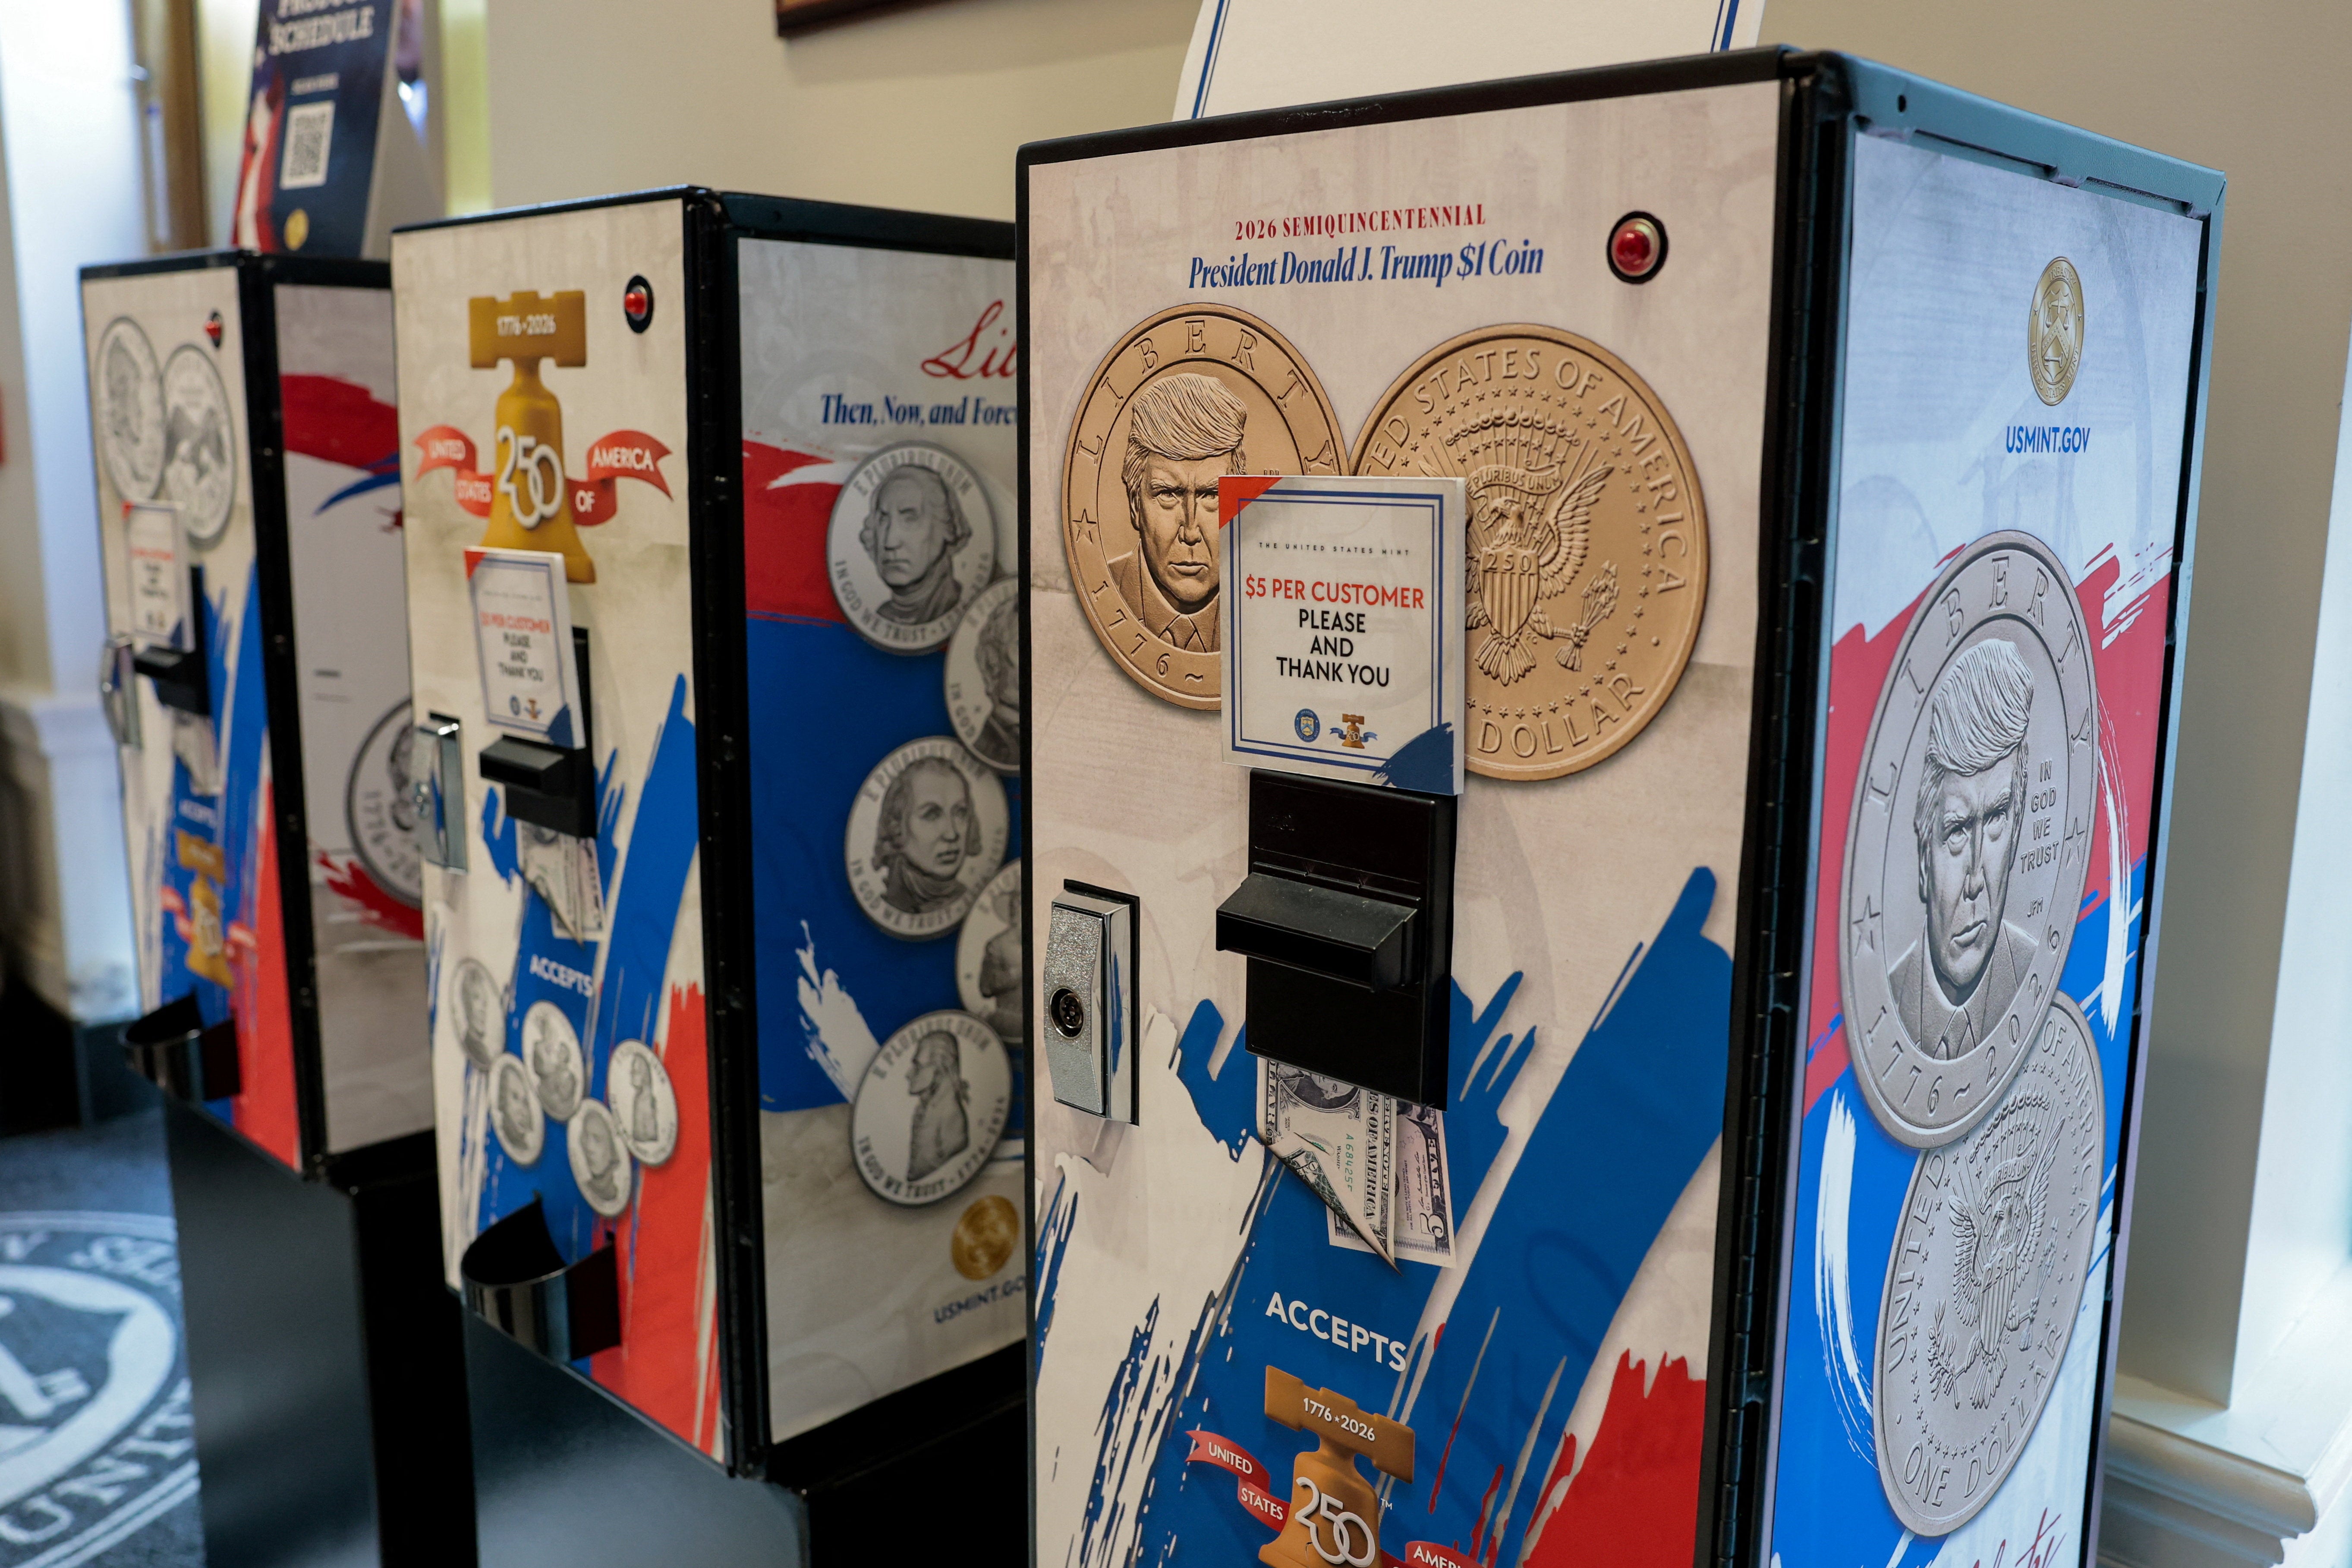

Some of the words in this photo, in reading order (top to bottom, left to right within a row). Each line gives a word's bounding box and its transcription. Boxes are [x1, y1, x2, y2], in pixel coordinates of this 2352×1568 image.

[268, 5, 375, 56] SCHEDULE
[1234, 219, 1277, 241] 2026
[1283, 203, 1486, 239] SEMIQUINCENTENNIAL
[1189, 252, 1278, 289] President
[1279, 246, 1357, 284] Donald
[1357, 246, 1373, 281] J.
[1381, 244, 1454, 287] Trump
[1457, 239, 1486, 280] $1
[1489, 239, 1544, 276] Coin
[2049, 267, 2076, 288] TREASURY
[497, 316, 521, 336] 1776
[526, 315, 556, 336] 2026
[2046, 382, 2065, 398] STATES
[2068, 346, 2078, 383] MINT
[822, 393, 878, 427] Then,
[882, 394, 925, 427] Now,
[929, 396, 968, 425] and
[1076, 320, 1336, 474] LIBERTY
[428, 438, 466, 461] UNITED
[2006, 425, 2091, 453] USMINT.GOV
[592, 446, 655, 472] AMERICA
[1414, 348, 1541, 415] STATES
[1555, 358, 1603, 399] OF
[1598, 393, 1688, 595] AMERICA
[456, 479, 492, 504] STATES
[497, 425, 564, 529] 250
[1472, 468, 1526, 487] PLURIBUS
[1528, 475, 1560, 491] UNUM
[575, 490, 595, 512] OF
[1487, 553, 1532, 573] 250
[1246, 574, 1266, 599] $5
[1272, 579, 1306, 600] PER
[1312, 581, 1424, 609] CUSTOMER
[1092, 581, 1171, 678] 1776
[1299, 609, 1366, 633] PLEASE
[1310, 635, 1354, 657] AND
[1276, 656, 1343, 683] THANK
[1348, 664, 1389, 687] YOU
[1865, 556, 2091, 816] LIBERTY
[1477, 673, 1645, 758] DOLLAR
[1347, 729, 1360, 742] 250
[2040, 761, 2053, 782] IN
[2031, 787, 2057, 812] GOD
[2033, 817, 2051, 841] WE
[2021, 841, 2060, 874] TRUST
[2028, 897, 2043, 918] JFM
[529, 954, 594, 998] ACCEPTS
[1867, 1004, 1943, 1117] 1776
[1985, 925, 2060, 1087] 2026
[1366, 1117, 1379, 1141] OF
[2041, 1018, 2067, 1057] OF
[2061, 1040, 2095, 1229] AMERICA
[1364, 1142, 1379, 1219] AMERICA
[1427, 1138, 1441, 1197] FIVE
[1419, 1213, 1444, 1238] 5
[1888, 1150, 1945, 1374] UNITED
[1987, 1253, 2012, 1284] 250
[933, 1275, 1026, 1324] USMINT.GO
[1265, 1291, 1407, 1372] ACCEPTS
[1303, 1398, 1332, 1422] 1776
[1341, 1415, 1376, 1442] 2026
[1904, 1441, 1950, 1507] ONE
[1965, 1324, 2064, 1498] DOLLAR
[1208, 1441, 1253, 1475] UNITED
[1241, 1487, 1284, 1521] STATES
[1381, 1498, 1393, 1511] TM
[1295, 1477, 1376, 1568] 250
